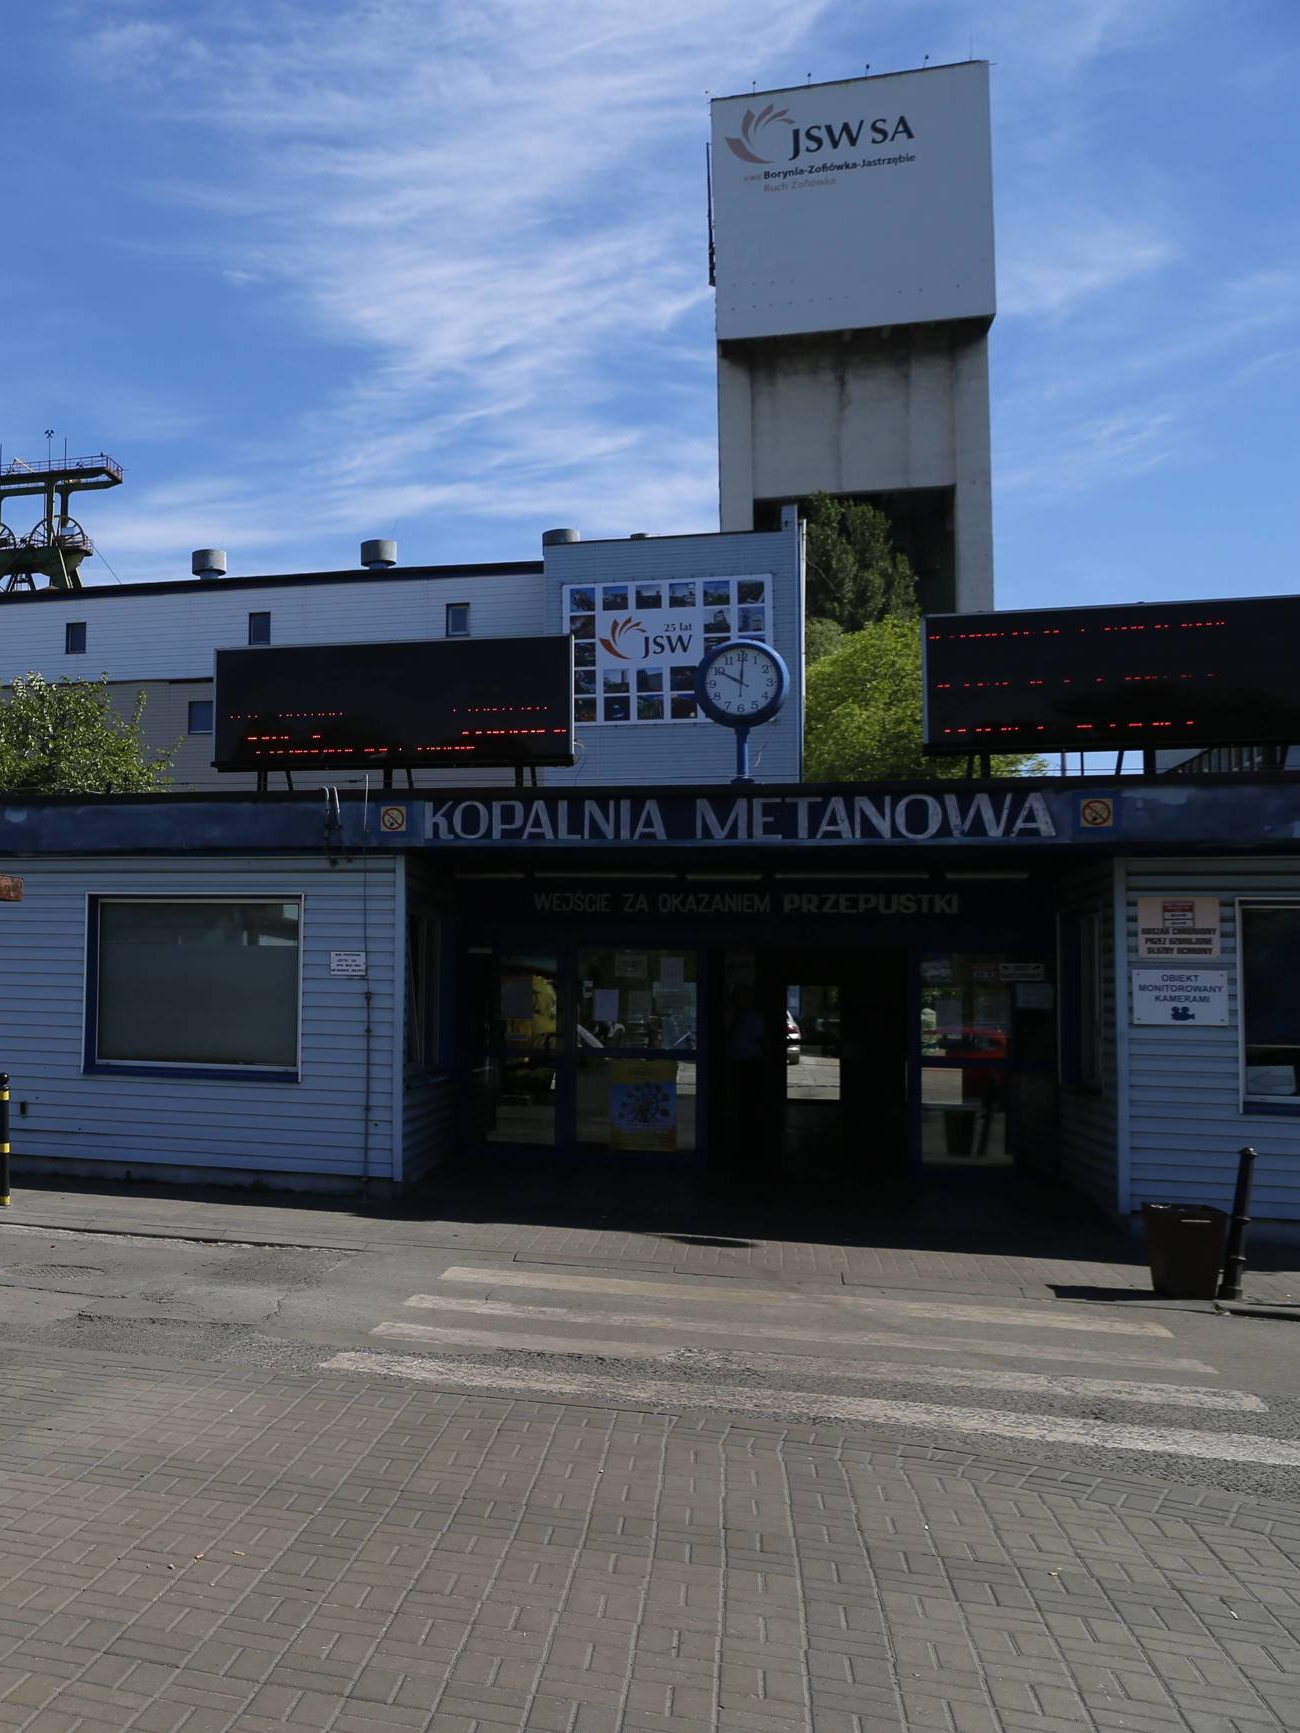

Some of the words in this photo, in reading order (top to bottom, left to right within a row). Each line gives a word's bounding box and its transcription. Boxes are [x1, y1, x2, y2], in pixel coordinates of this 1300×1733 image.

[788, 119, 865, 161] JSW
[870, 115, 916, 145] SA
[663, 623, 676, 633] 25
[680, 622, 692, 632] lat
[641, 634, 693, 660] JSW
[424, 800, 668, 840] KOPALNIA
[695, 792, 1057, 840] METANOWA
[533, 890, 611, 913] WEJŚCIE
[623, 894, 649, 912] ZA
[658, 894, 771, 913] OKAZANIEM
[783, 893, 960, 914] PRZEPUSTKI
[1161, 974, 1200, 983] OBIEKT
[1138, 984, 1224, 993] MONITOROWANY
[1154, 994, 1210, 1003] KAMERAMI
